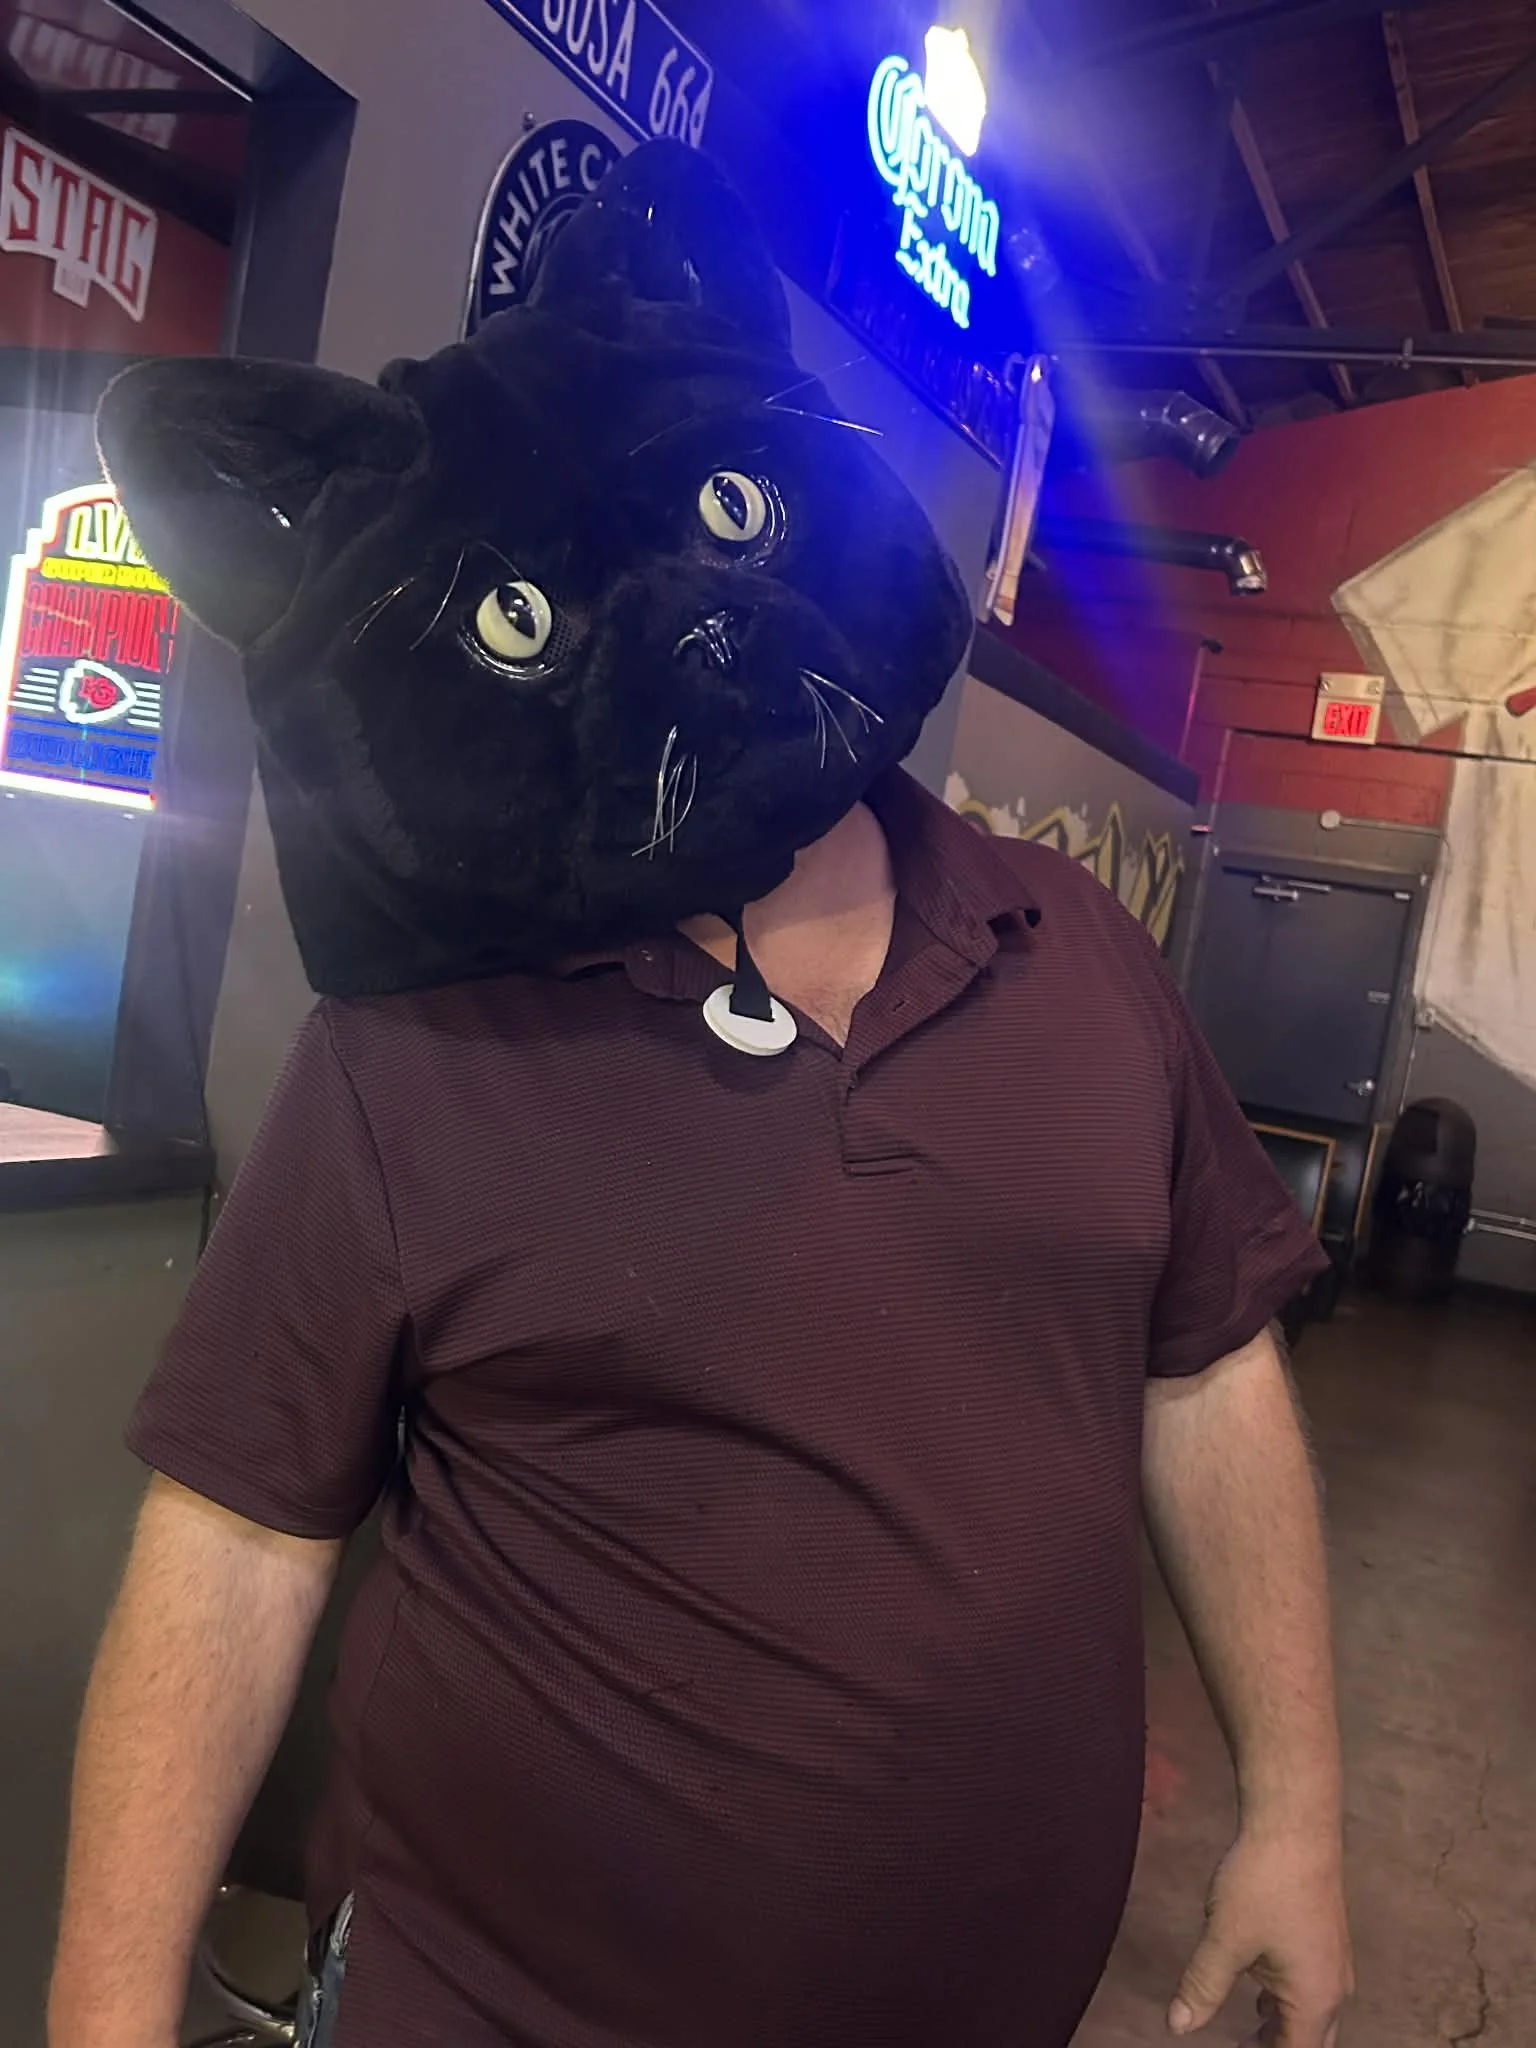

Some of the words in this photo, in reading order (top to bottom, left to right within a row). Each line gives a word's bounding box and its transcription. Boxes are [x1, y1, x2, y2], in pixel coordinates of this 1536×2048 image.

[8, 140, 150, 305] STAG
[489, 137, 571, 296] WHITE
[580, 144, 614, 192] C
[867, 55, 1000, 277] Corona
[893, 192, 970, 329] Extra
[1323, 702, 1374, 737] EXIT
